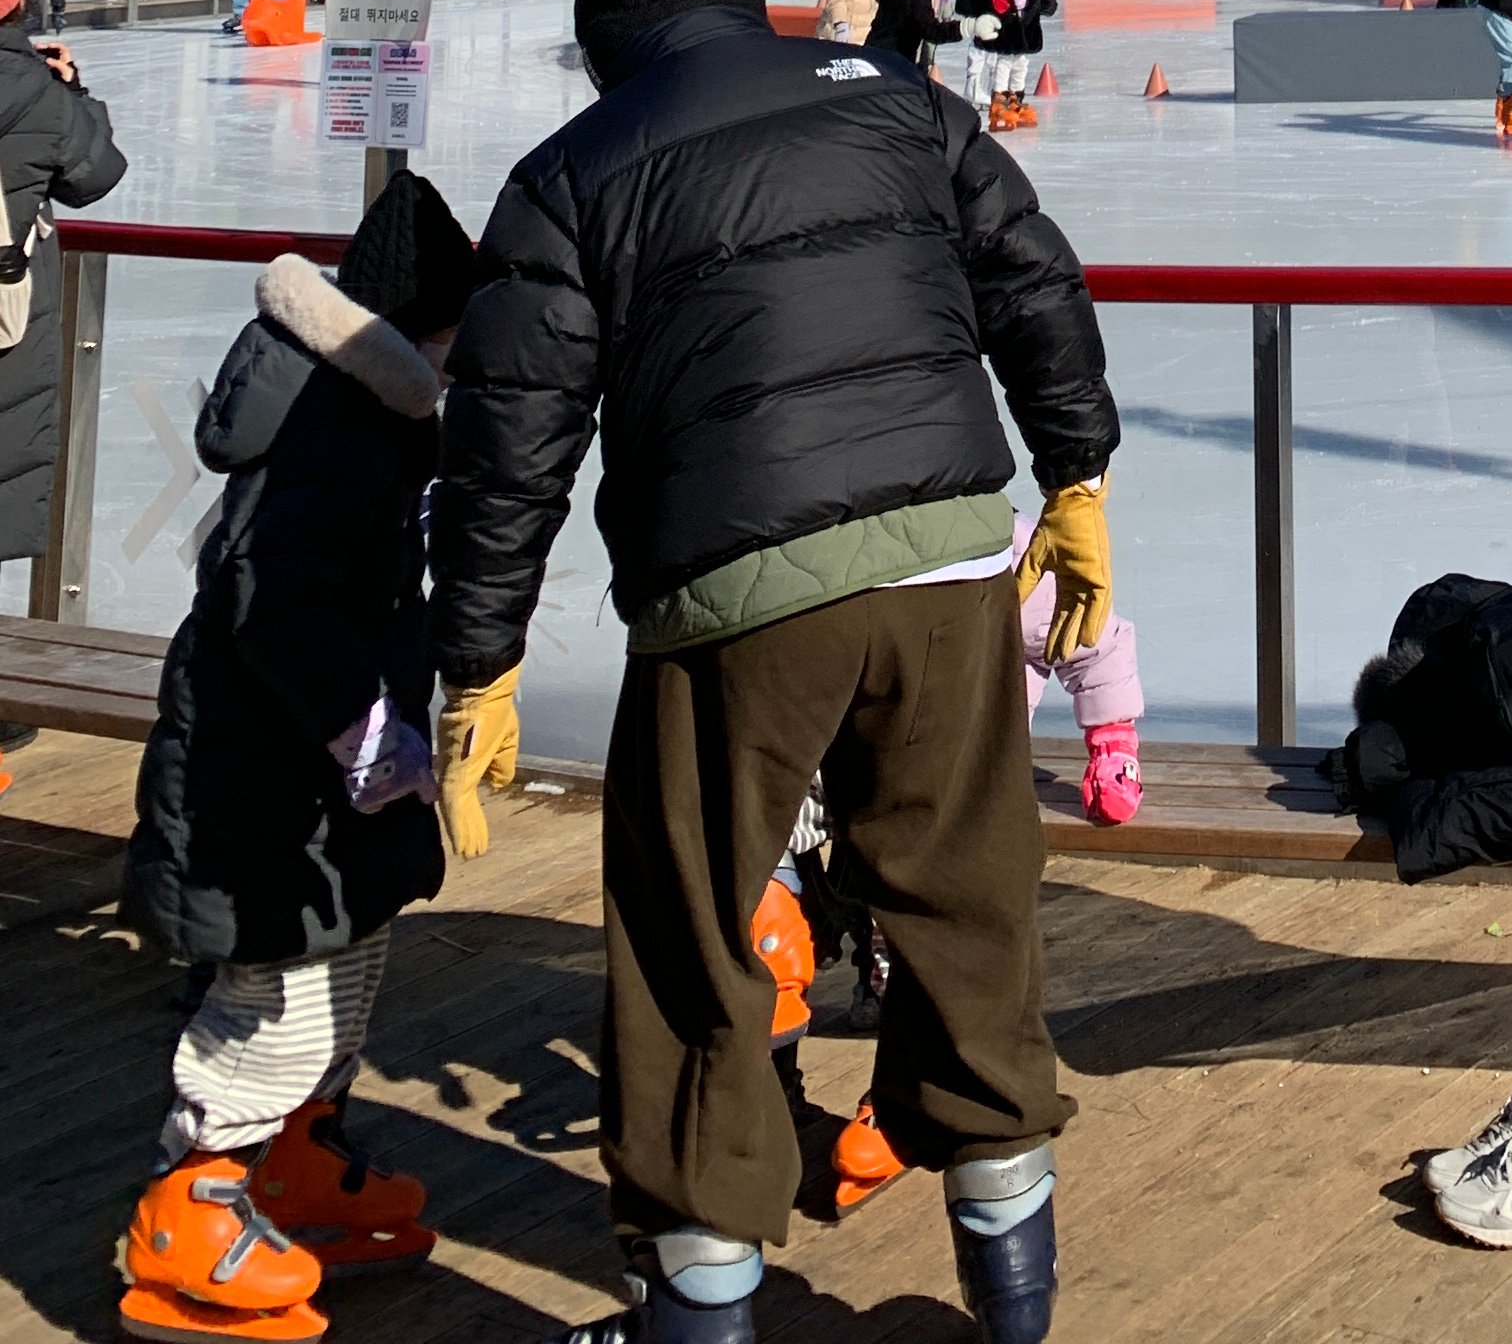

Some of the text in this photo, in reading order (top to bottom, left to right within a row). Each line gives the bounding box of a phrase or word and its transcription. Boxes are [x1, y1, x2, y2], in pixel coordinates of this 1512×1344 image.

[339, 7, 420, 24] 절대 뛰지마세요
[830, 58, 852, 68] THE
[815, 65, 857, 78] NORTH
[831, 71, 860, 82] FACE
